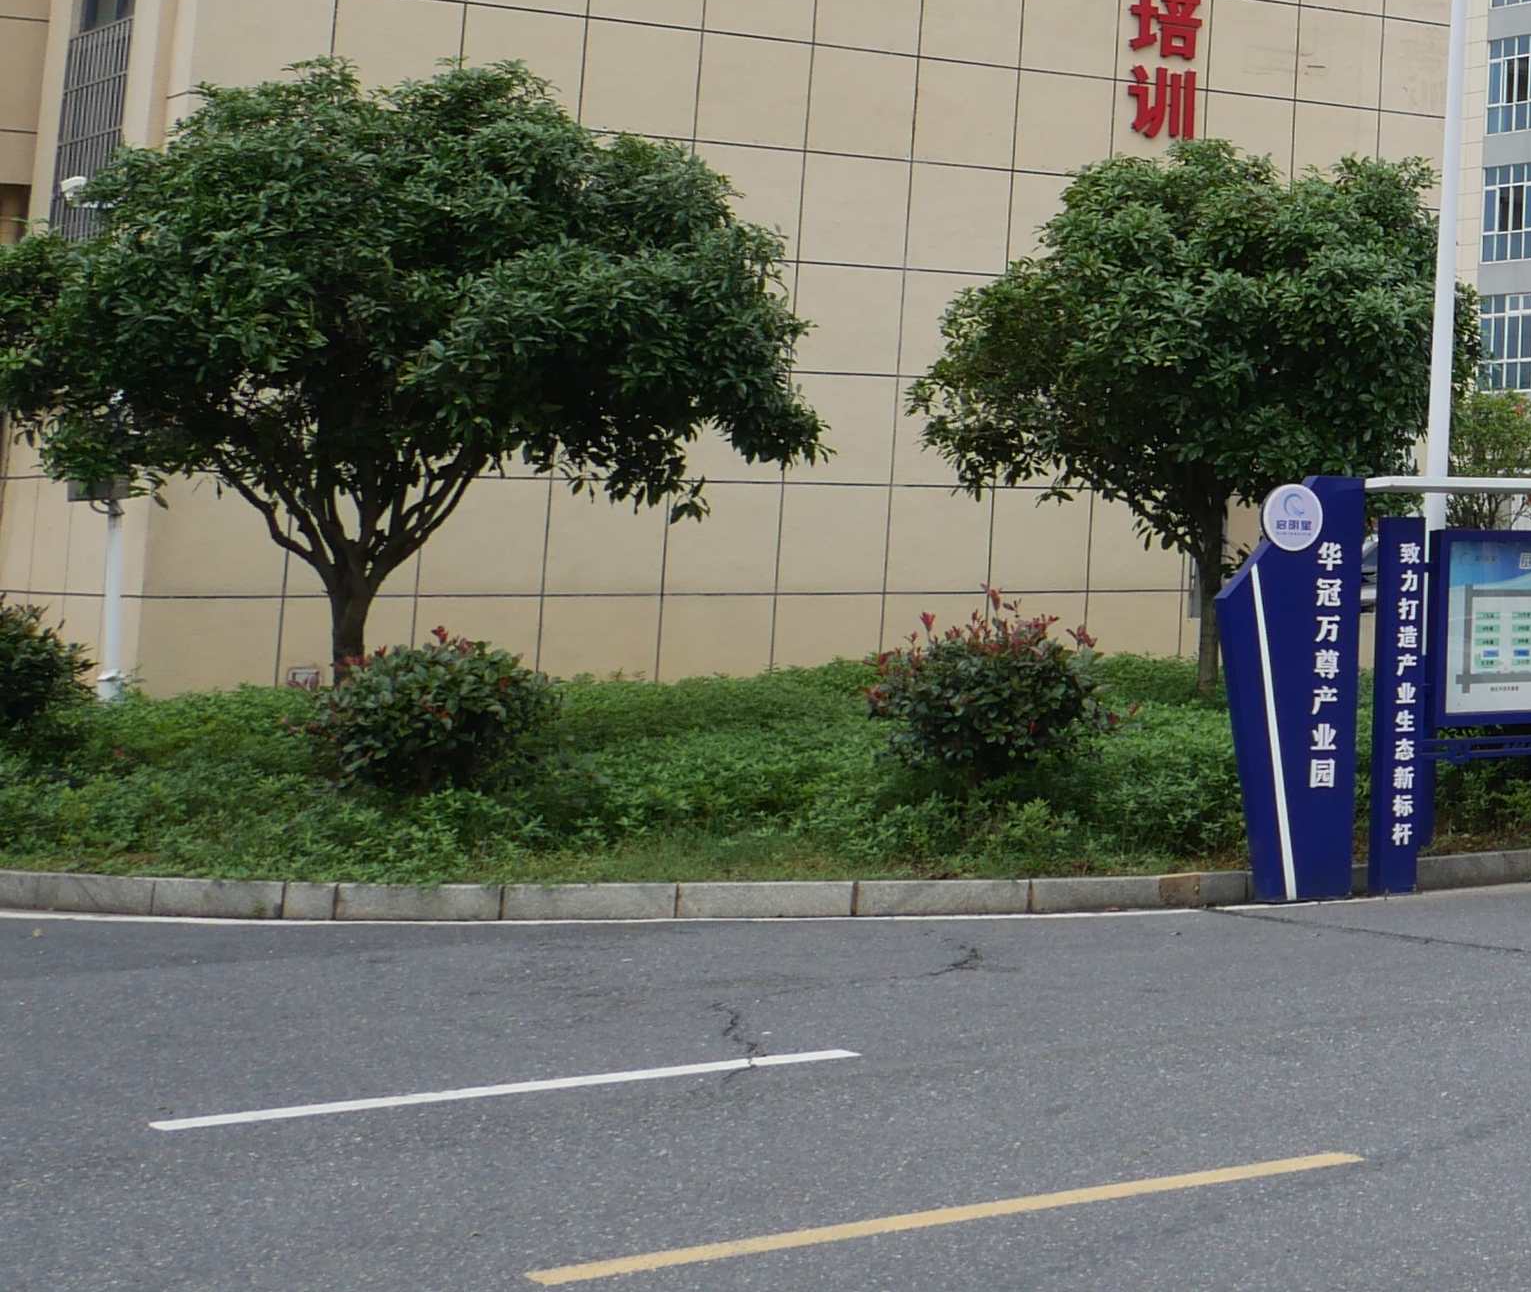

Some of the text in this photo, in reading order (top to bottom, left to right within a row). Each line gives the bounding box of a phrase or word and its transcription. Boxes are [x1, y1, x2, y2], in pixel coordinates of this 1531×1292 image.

[1275, 519, 1312, 531] 启明星
[1308, 541, 1343, 789] 华冠万尊产业园
[1391, 542, 1421, 847] 致力打造产业生态新标杆
